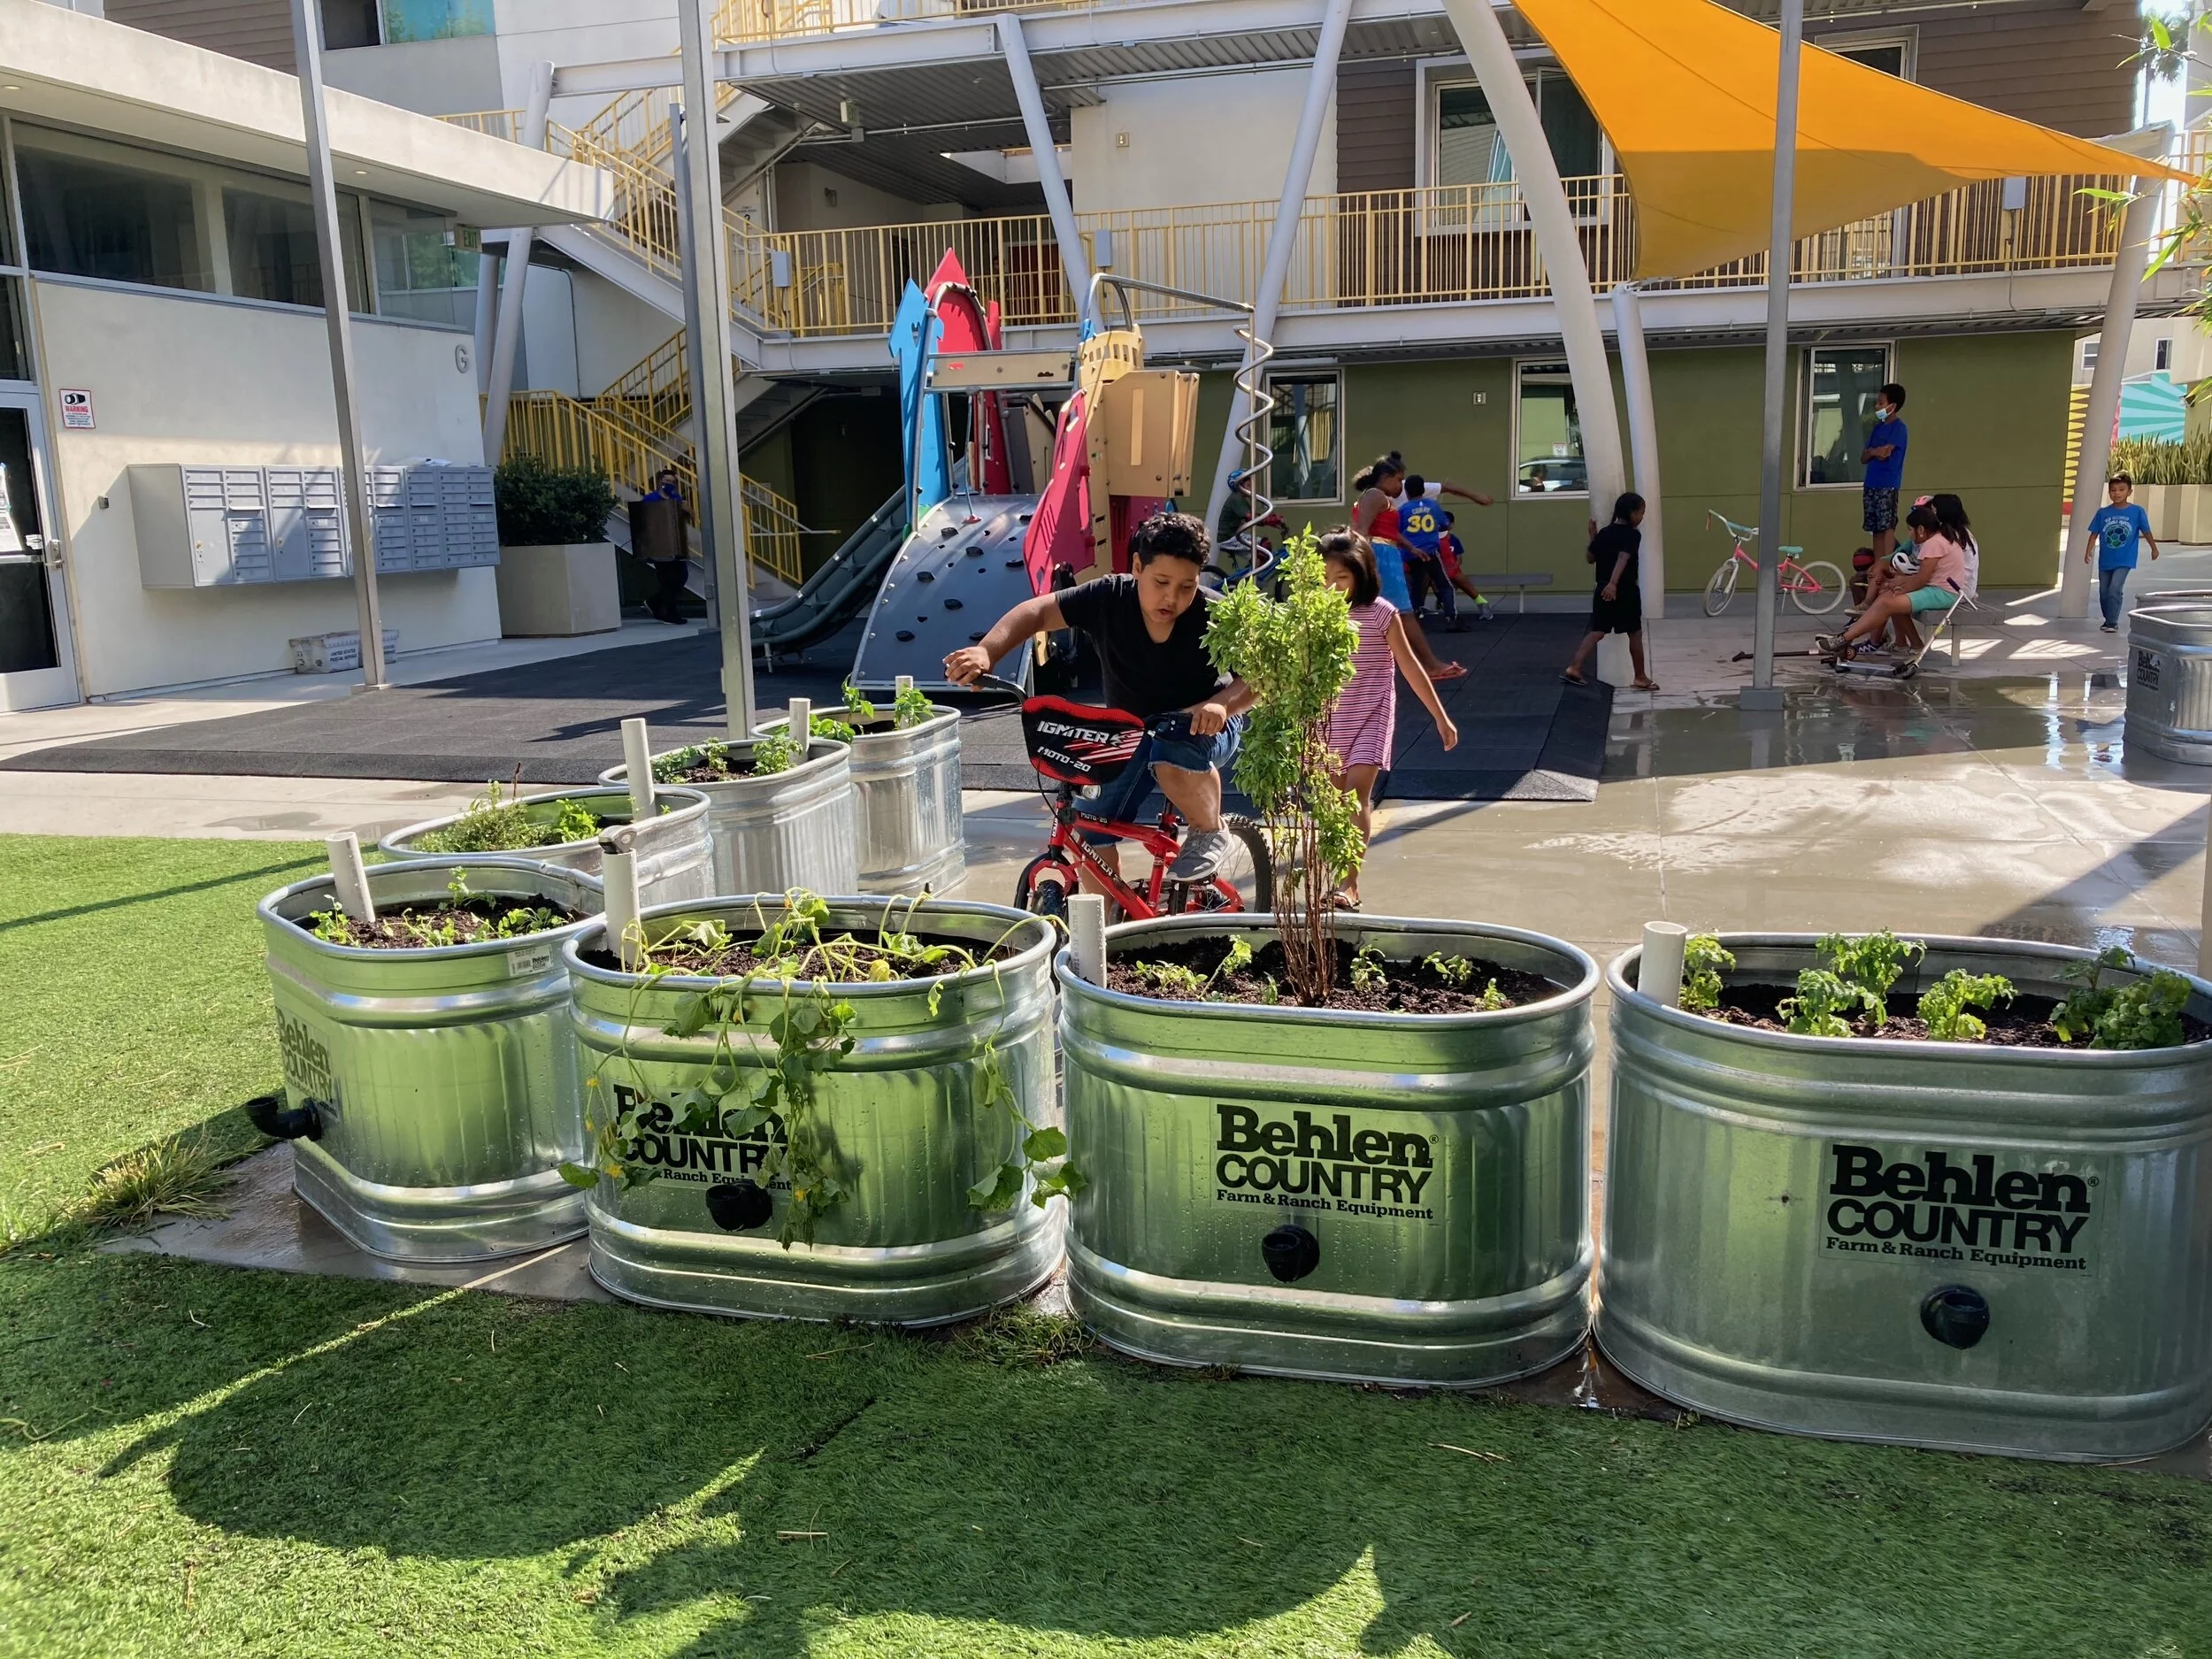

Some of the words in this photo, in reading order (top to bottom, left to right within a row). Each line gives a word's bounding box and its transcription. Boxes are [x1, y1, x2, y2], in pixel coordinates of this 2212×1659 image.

[455, 344, 469, 373] G
[1407, 514, 1435, 533] 30
[1036, 720, 1110, 744] IGNITER
[1037, 746, 1092, 772] MOTO-20
[1080, 812, 1108, 824] MOTO-20
[1081, 842, 1113, 877] IGNITER
[664, 1168, 709, 1183] Ranch
[1216, 1153, 1432, 1204] COUNTRY
[1337, 1199, 1433, 1219] Equipment
[1827, 1198, 2090, 1254] COUNTRY
[1970, 1248, 2086, 1270] Equipment
